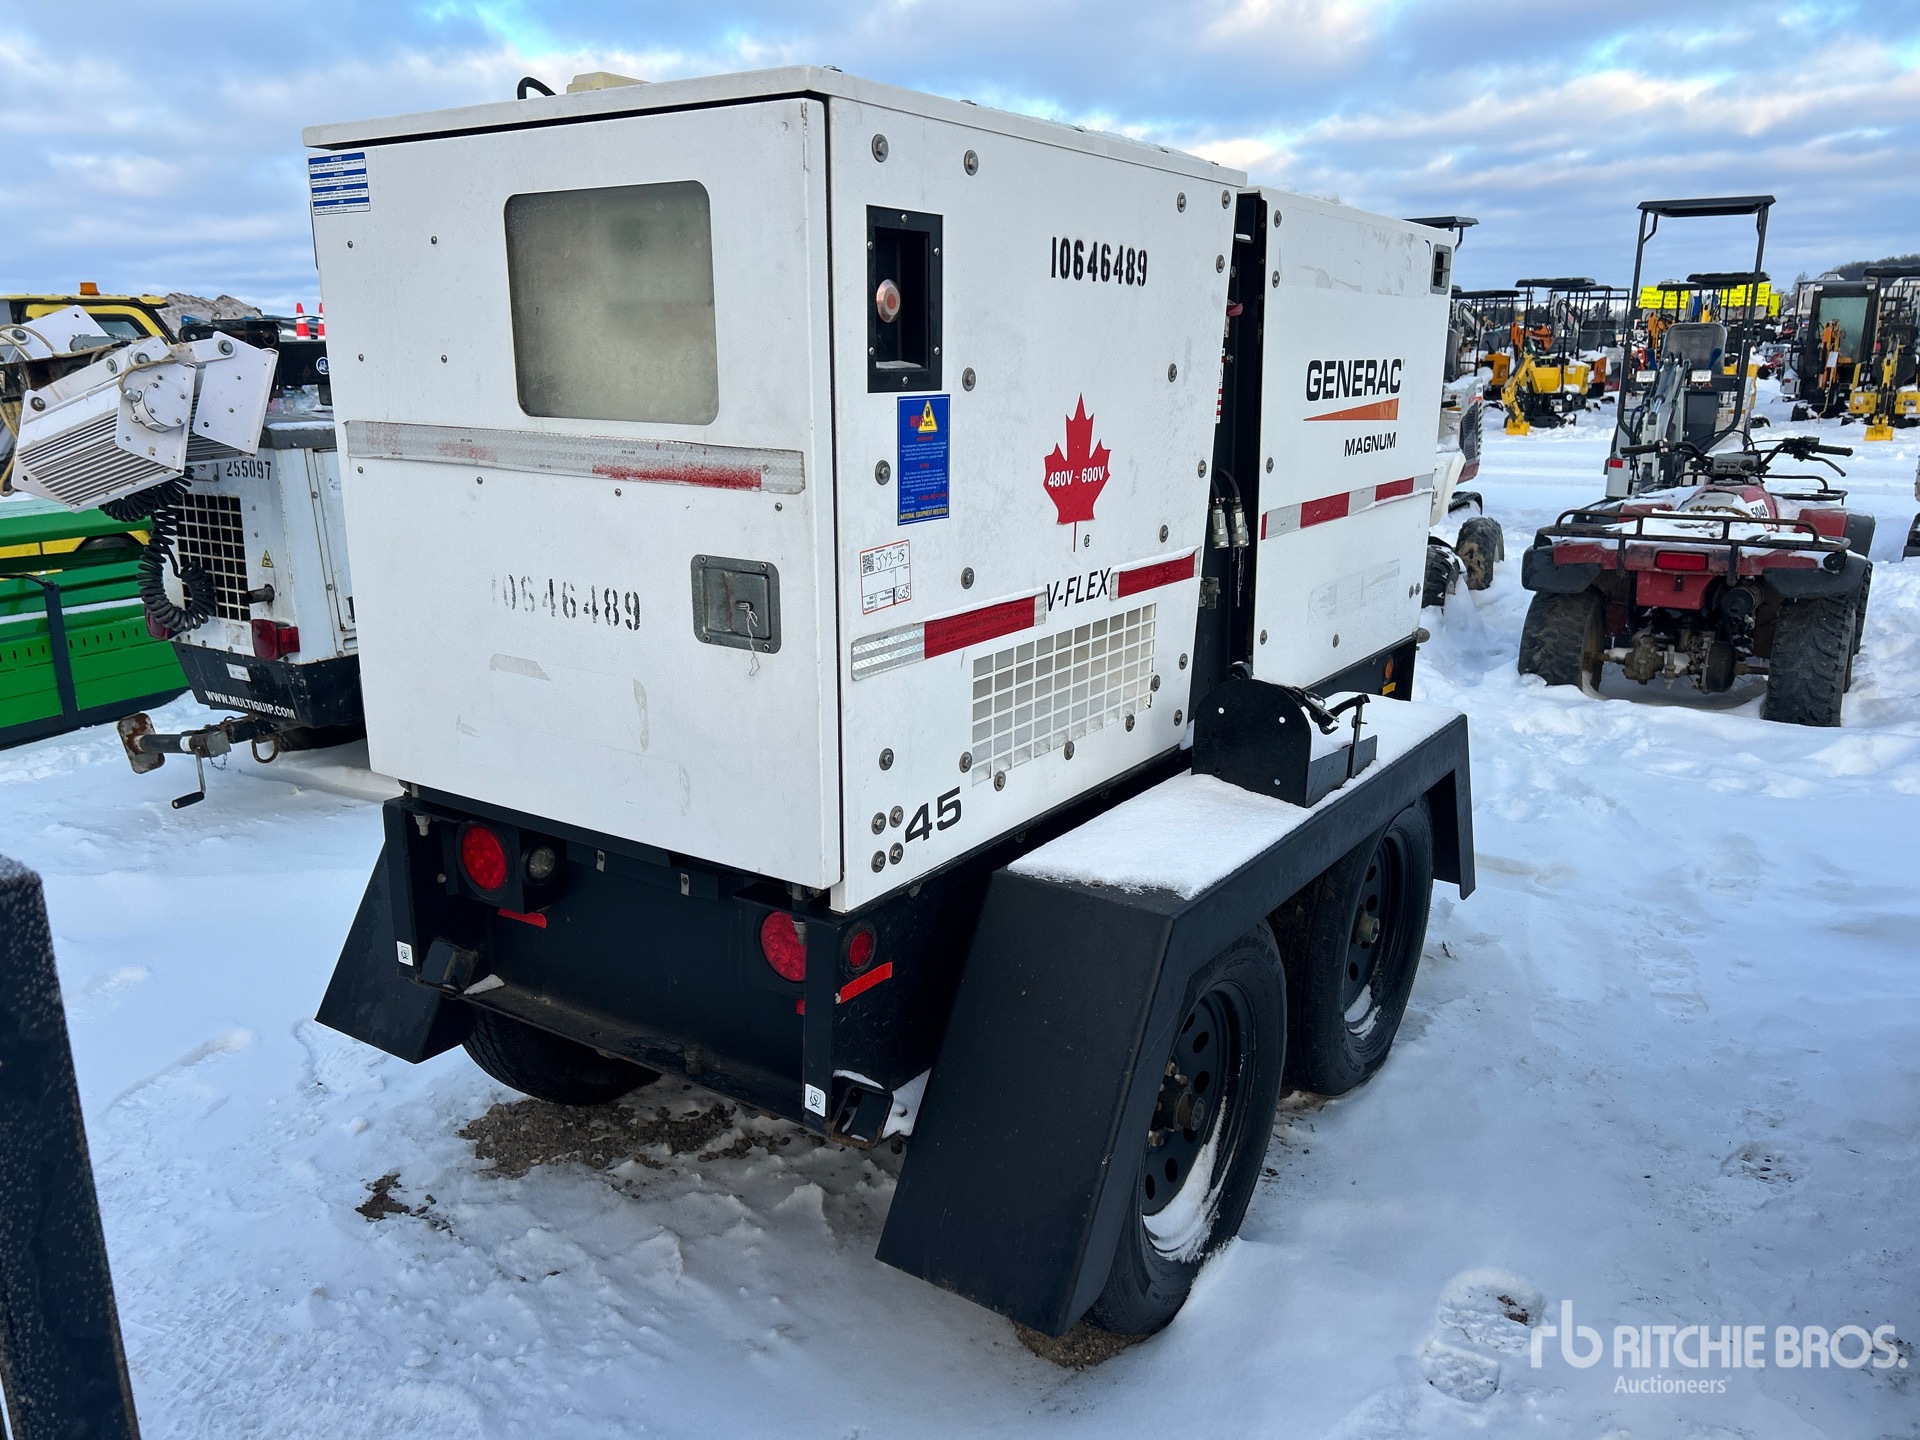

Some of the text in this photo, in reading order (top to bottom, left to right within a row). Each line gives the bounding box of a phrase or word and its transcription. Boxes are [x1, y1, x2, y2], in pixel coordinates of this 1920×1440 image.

[1051, 236, 1148, 287] 10646489
[1306, 359, 1402, 402] GENERAC
[1344, 432, 1397, 457] MAGNUM
[226, 461, 272, 480] 255097
[1048, 470, 1074, 488] 480V
[1081, 466, 1105, 483] 600V
[1046, 567, 1111, 612] V-FLEX
[205, 690, 297, 720] WWW.MULTIQUIP.COM
[905, 786, 961, 844] 45
